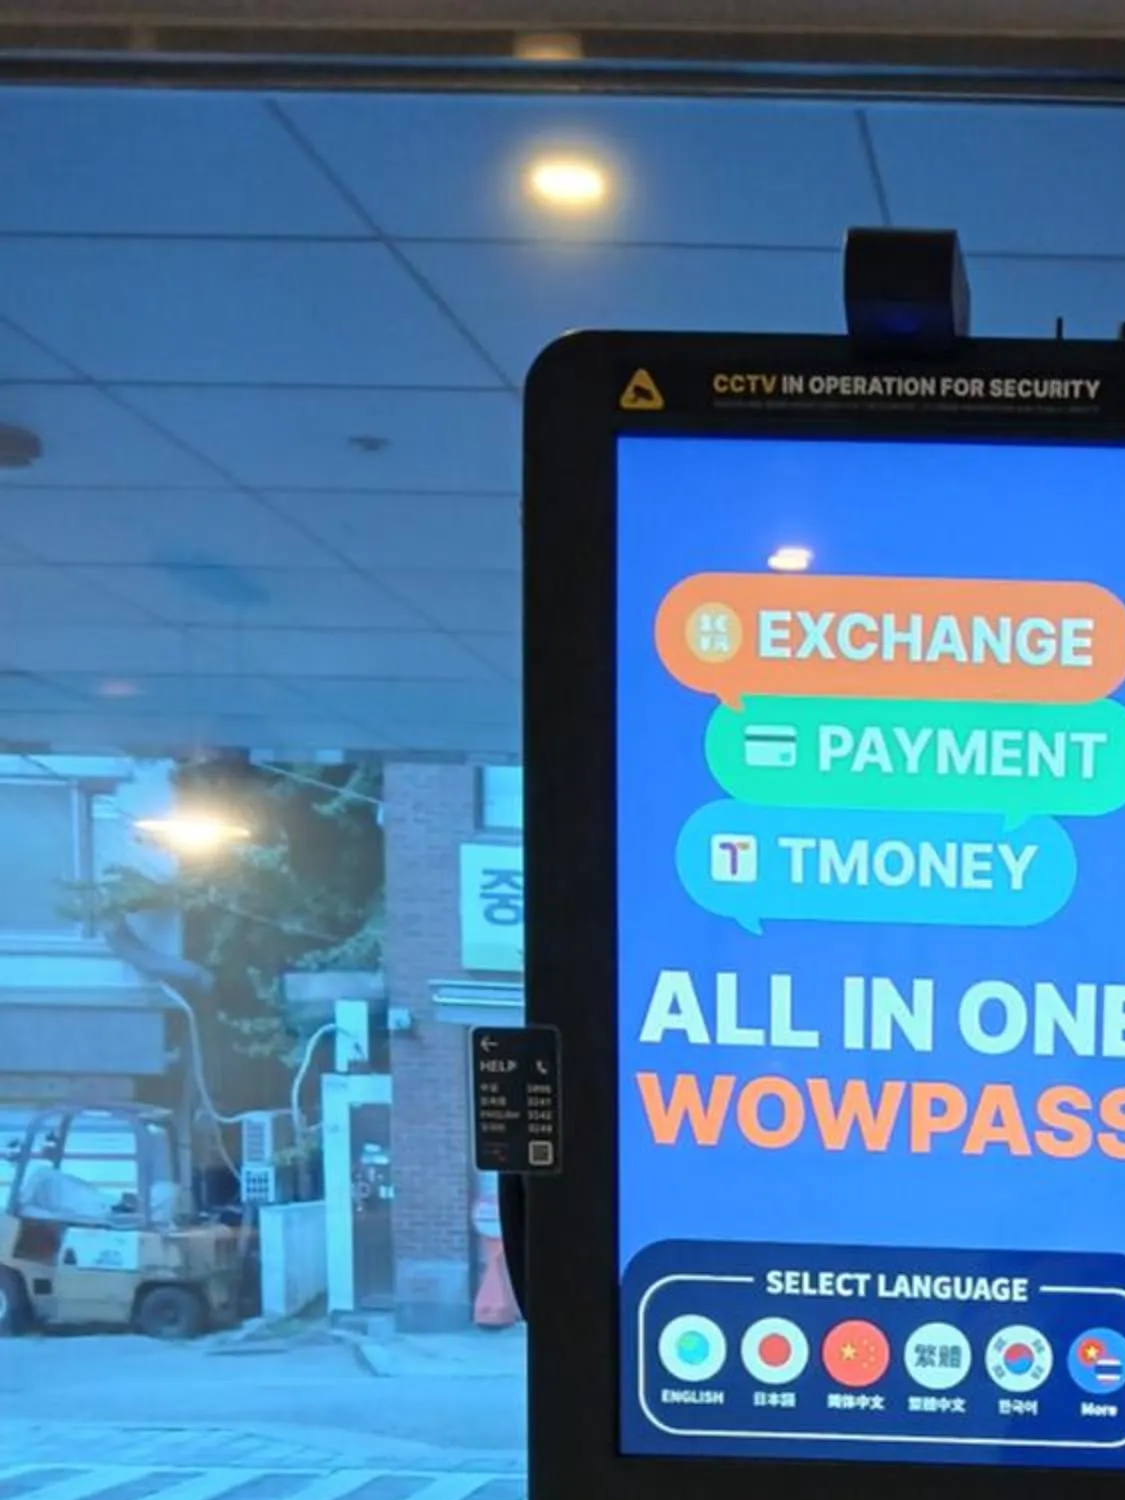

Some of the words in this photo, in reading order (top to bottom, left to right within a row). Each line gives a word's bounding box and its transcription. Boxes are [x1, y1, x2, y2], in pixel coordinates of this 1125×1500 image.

[713, 374, 776, 394] CCTV
[782, 375, 803, 393] IN
[809, 376, 935, 396] OPERATION
[941, 378, 983, 397] FOR
[989, 379, 1101, 399] SECURITY
[758, 610, 1093, 668] EXCHANGE
[818, 726, 1107, 780] PAYMENT
[778, 837, 1038, 891] TMONEY
[639, 969, 819, 1048] ALL
[844, 976, 934, 1052] IN
[480, 1060, 517, 1073] HELP
[766, 1271, 870, 1298] SELECT
[878, 1274, 1028, 1302] LANGUAGE
[661, 1389, 724, 1405] ENGLISH
[998, 1399, 1038, 1416] 한국어
[1081, 1402, 1118, 1417] More
